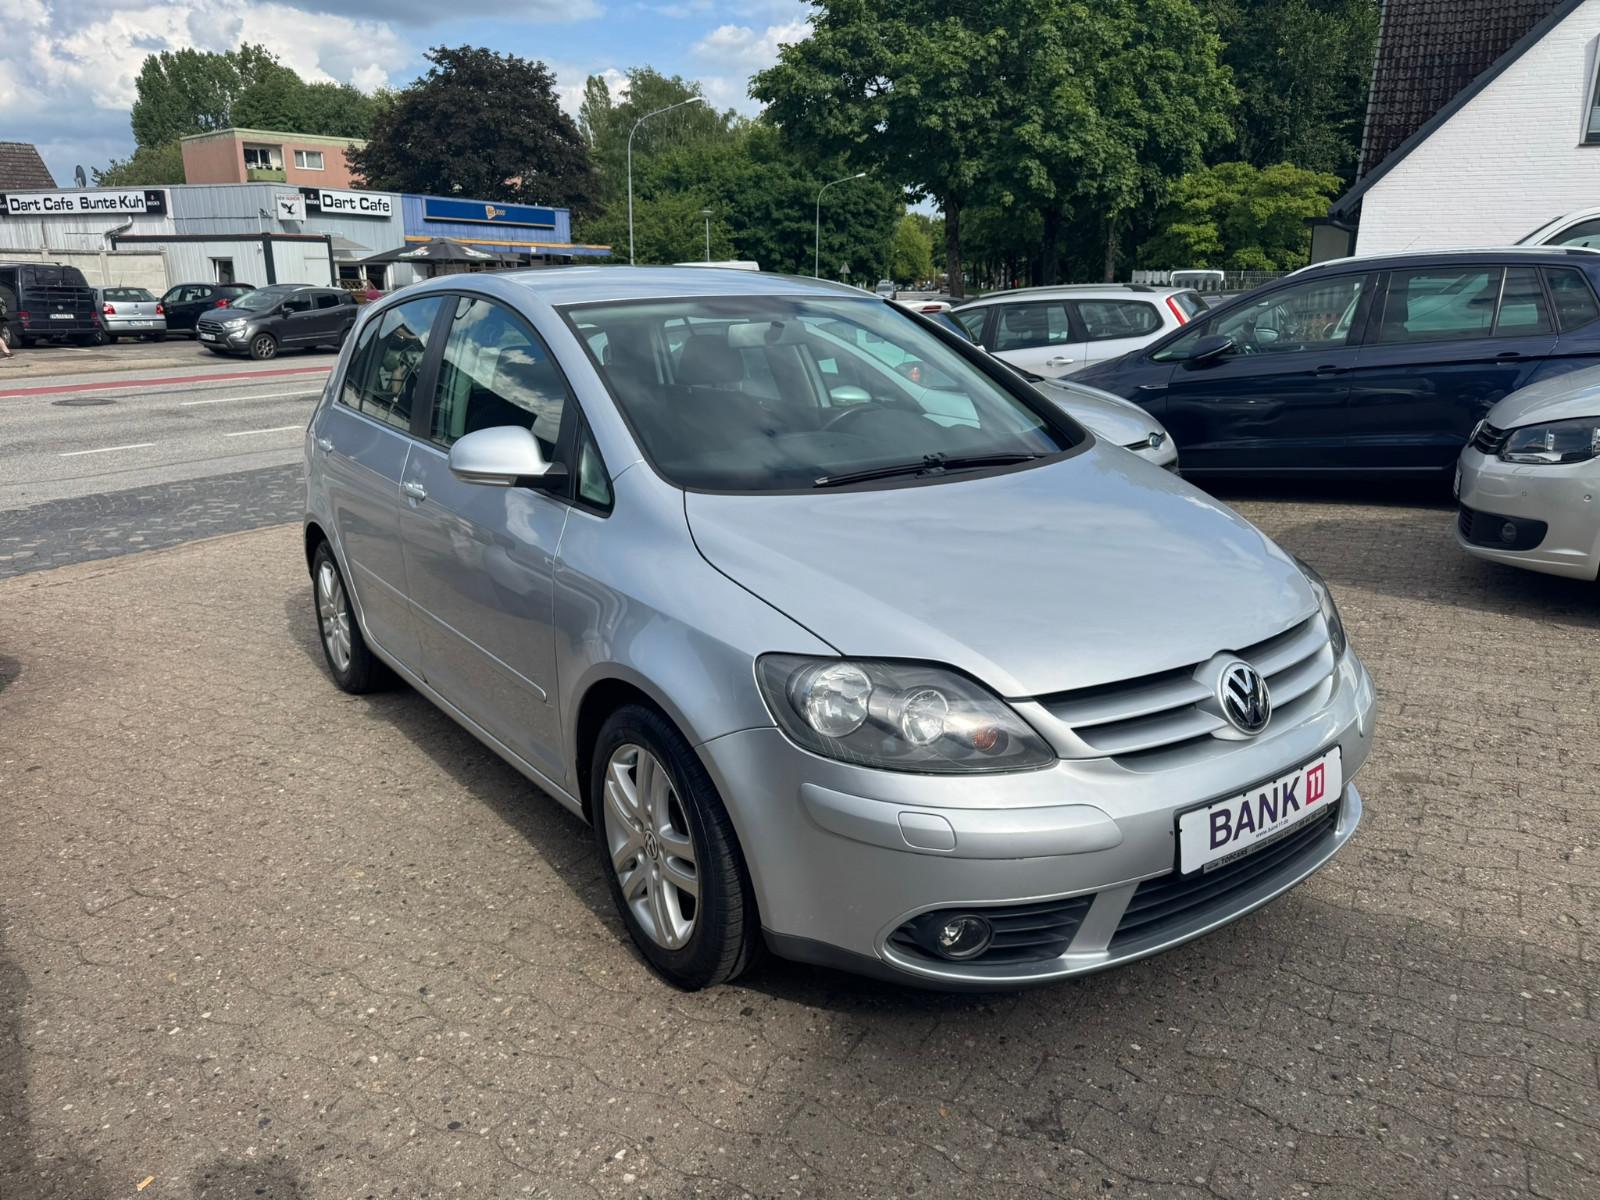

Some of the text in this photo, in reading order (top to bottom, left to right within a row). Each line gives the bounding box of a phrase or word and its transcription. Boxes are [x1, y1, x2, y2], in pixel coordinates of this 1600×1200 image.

[9, 195, 145, 211] Dart Cafe Bunte Kuh
[322, 194, 357, 210] Dart
[359, 197, 390, 212] Cafe
[1209, 776, 1300, 851] BANK
